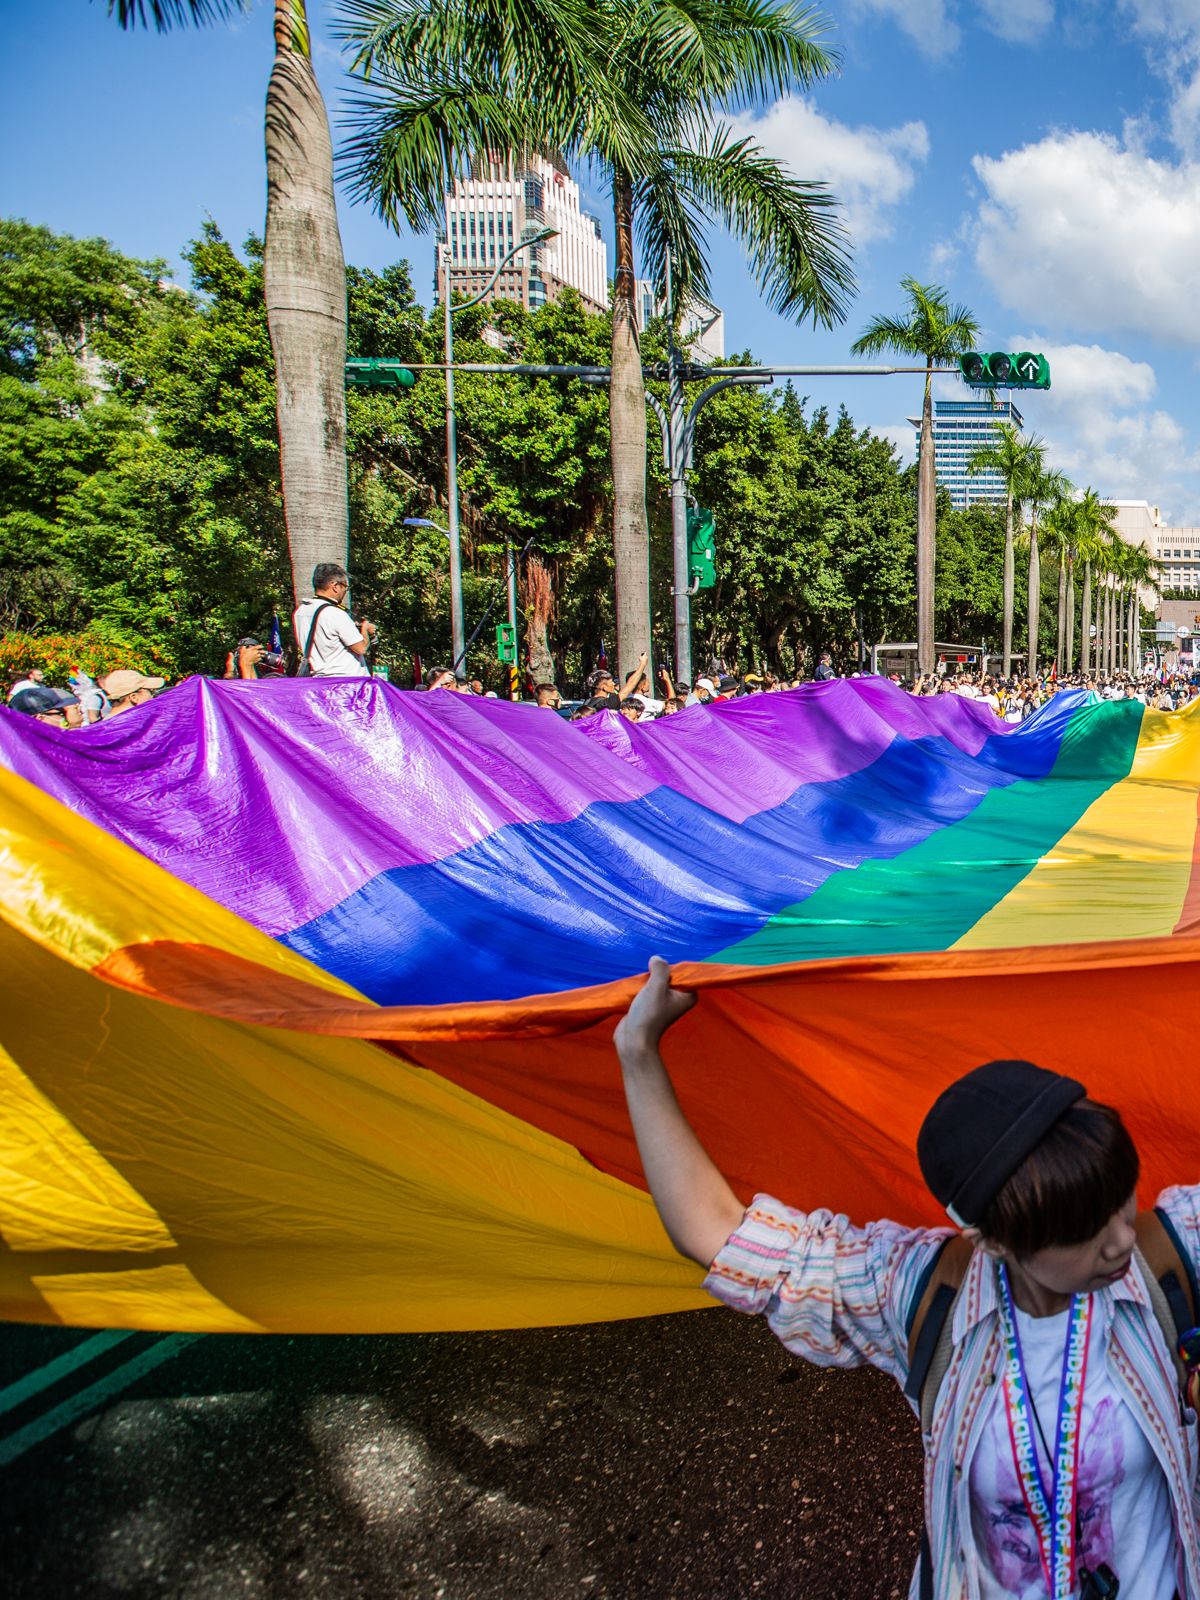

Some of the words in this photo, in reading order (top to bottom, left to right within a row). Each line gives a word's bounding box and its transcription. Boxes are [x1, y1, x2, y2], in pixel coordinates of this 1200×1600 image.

[1065, 1319, 1088, 1385] PRIDE
[1011, 1405, 1036, 1476] PRIDE
[1060, 1411, 1077, 1433] 18
[1055, 1438, 1076, 1516] YEARS
[1023, 1479, 1050, 1528] LGBT
[1055, 1519, 1072, 1549] OF
[1054, 1552, 1072, 1597] AGE
